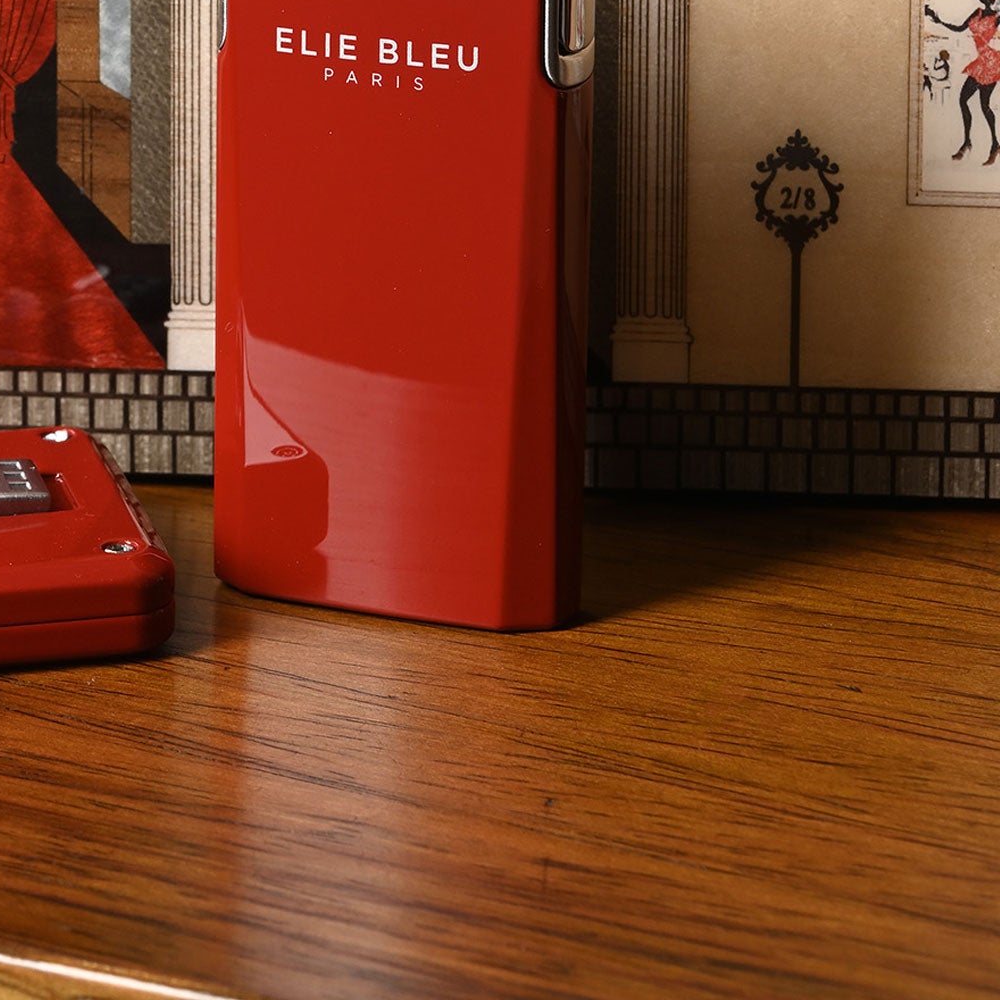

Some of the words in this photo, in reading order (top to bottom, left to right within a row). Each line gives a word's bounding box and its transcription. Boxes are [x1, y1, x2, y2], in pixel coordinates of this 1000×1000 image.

[275, 26, 358, 61] ELIE
[379, 38, 479, 72] BLEU
[323, 67, 424, 91] PARIS
[780, 186, 816, 211] 2/8
